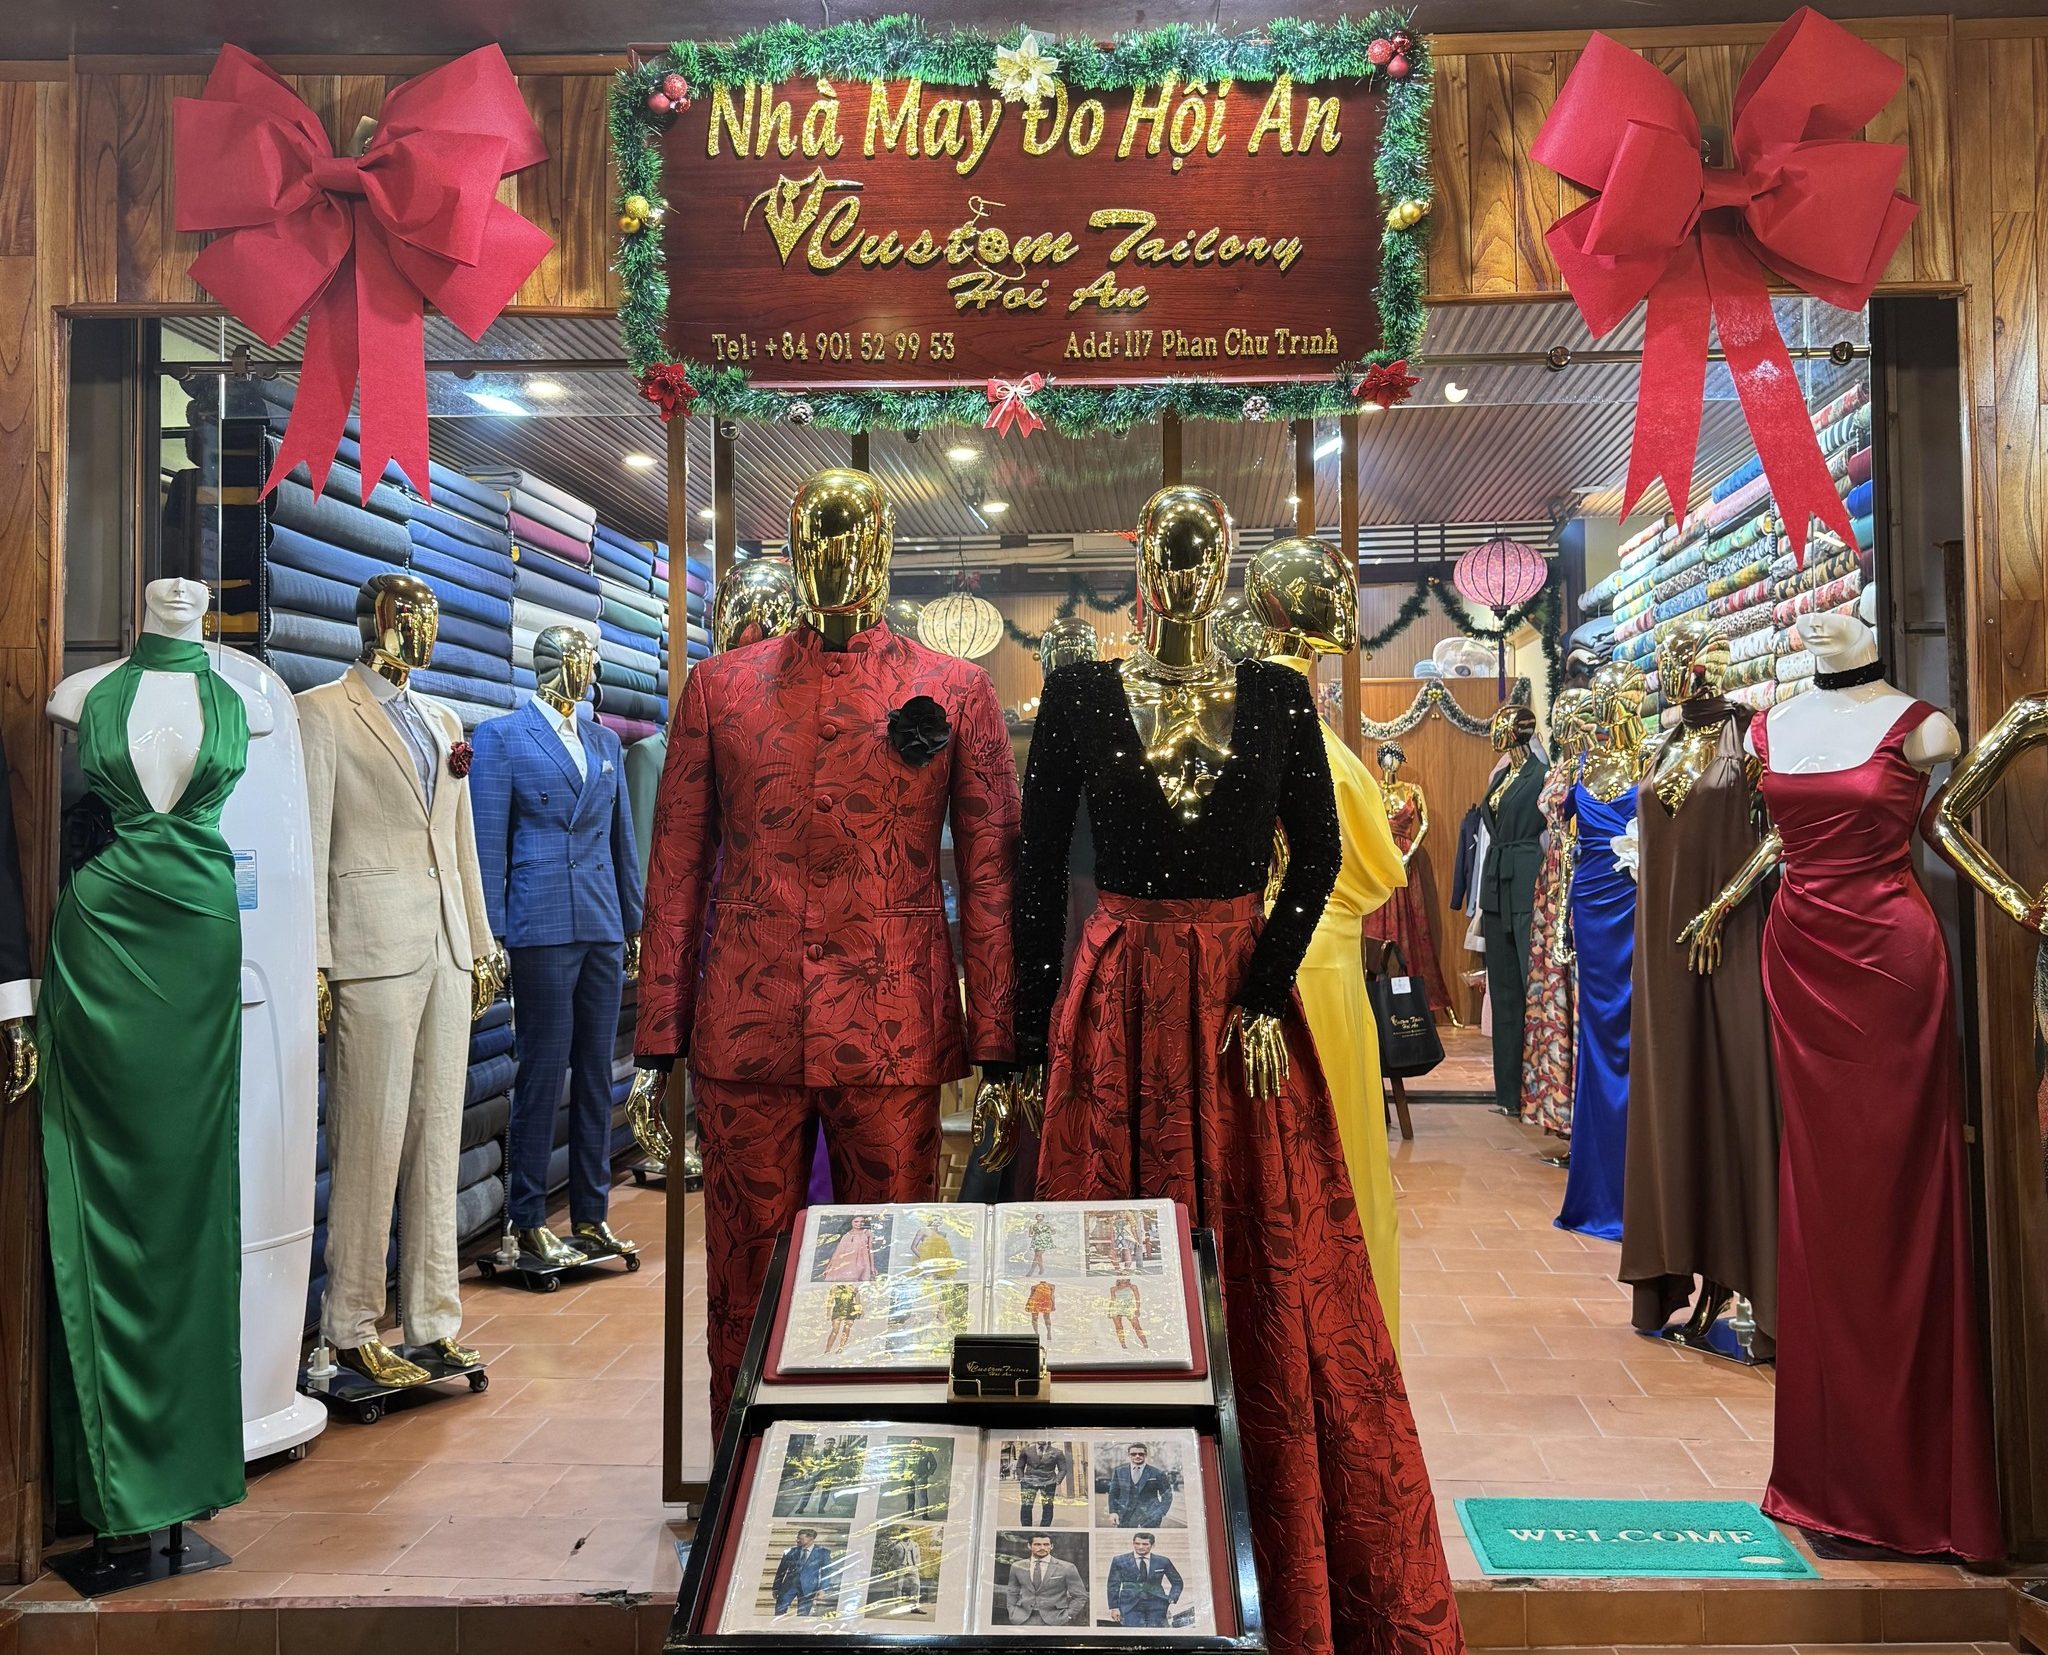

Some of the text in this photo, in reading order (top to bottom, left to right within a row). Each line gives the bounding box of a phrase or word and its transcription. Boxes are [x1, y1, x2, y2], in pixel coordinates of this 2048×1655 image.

[706, 70, 1342, 175] Nhà May Đo Hội An
[807, 196, 1303, 272] Custom Tailory
[947, 270, 1150, 312] Hoi An
[711, 331, 956, 361] Tel: +84 901 52 99 53
[1161, 329, 1218, 358] Phan
[1224, 327, 1270, 356] Chu
[1507, 1527, 1761, 1545] WELCOME
